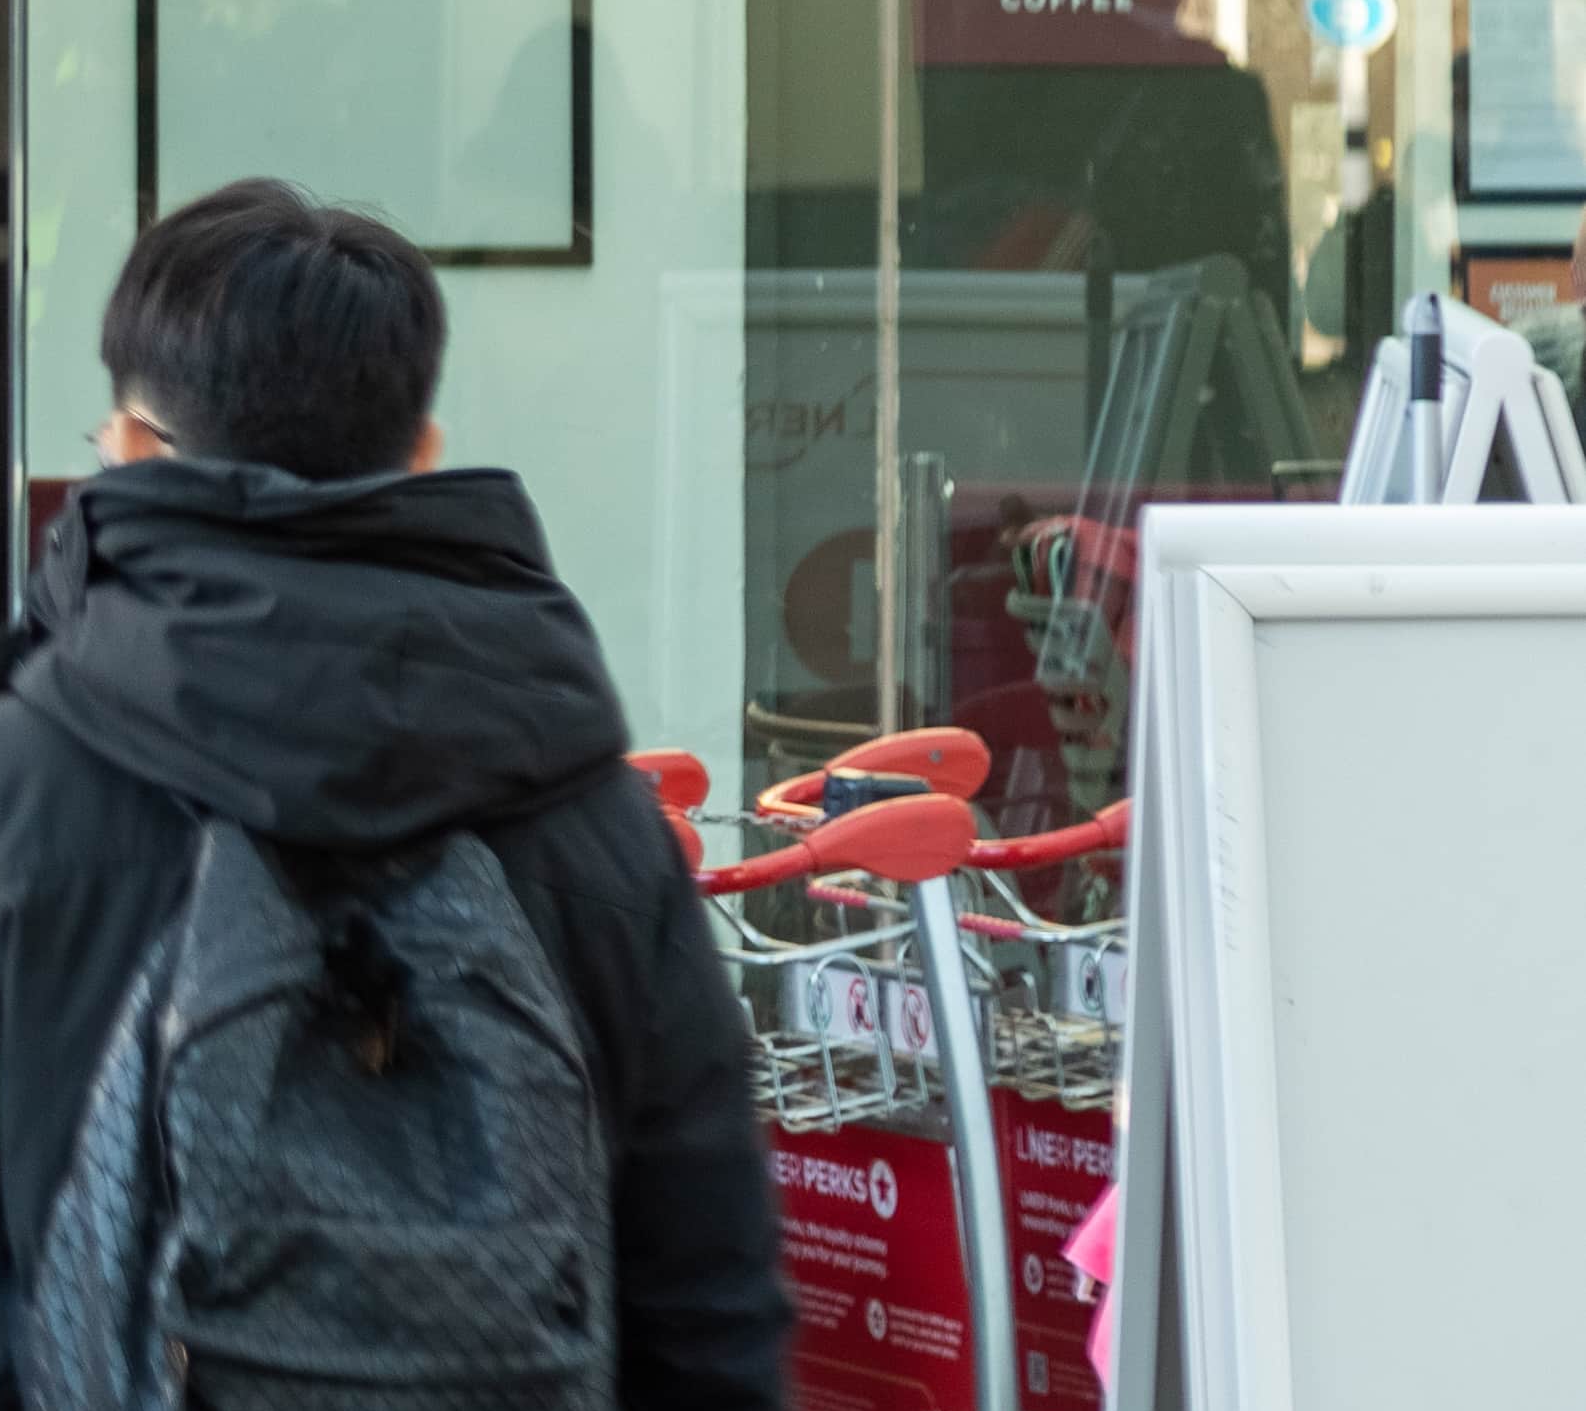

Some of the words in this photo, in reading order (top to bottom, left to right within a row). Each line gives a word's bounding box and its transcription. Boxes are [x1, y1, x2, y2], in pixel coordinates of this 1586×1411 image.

[1015, 1124, 1070, 1171] LNER
[1071, 1135, 1116, 1179] PER
[801, 1155, 868, 1204] PERKS
